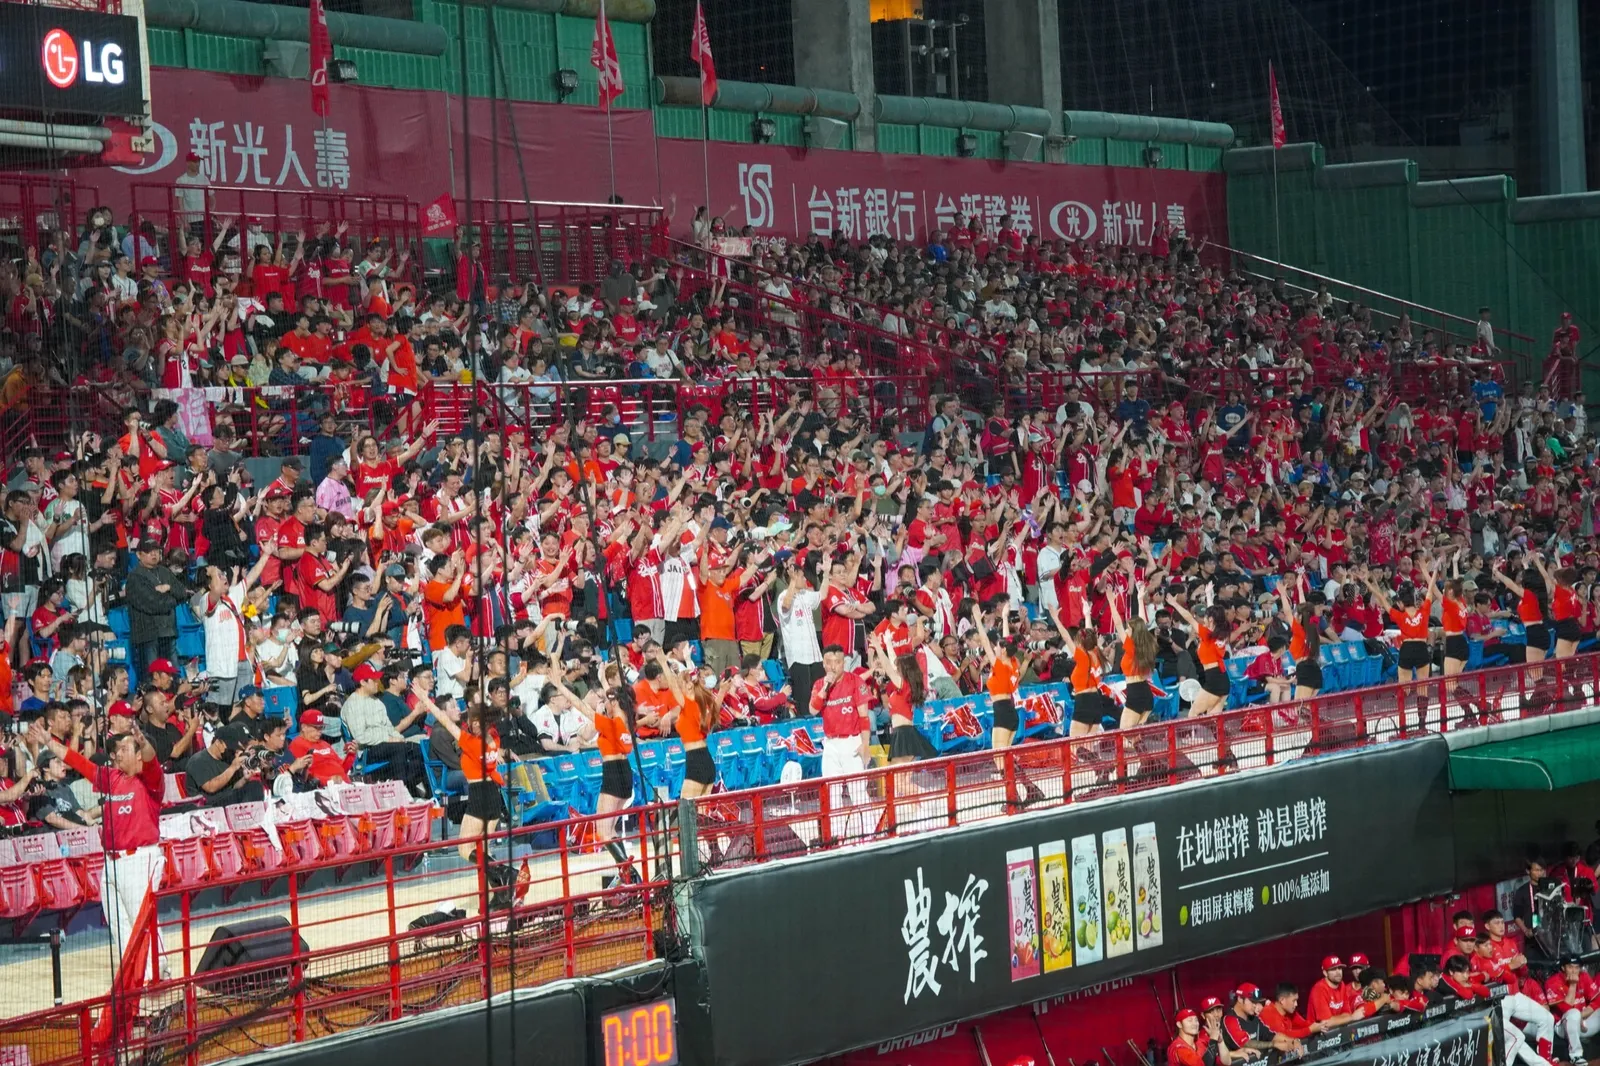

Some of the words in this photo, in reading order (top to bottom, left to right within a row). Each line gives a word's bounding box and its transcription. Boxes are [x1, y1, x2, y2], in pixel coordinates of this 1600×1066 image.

[83, 40, 125, 84] LG
[189, 117, 350, 190] 新光人壽
[808, 185, 916, 242] 台新銀行
[1257, 796, 1328, 853] 就是農搾
[1191, 887, 1254, 927] 使用屏東檸檬
[1272, 869, 1330, 905] 100%無添加
